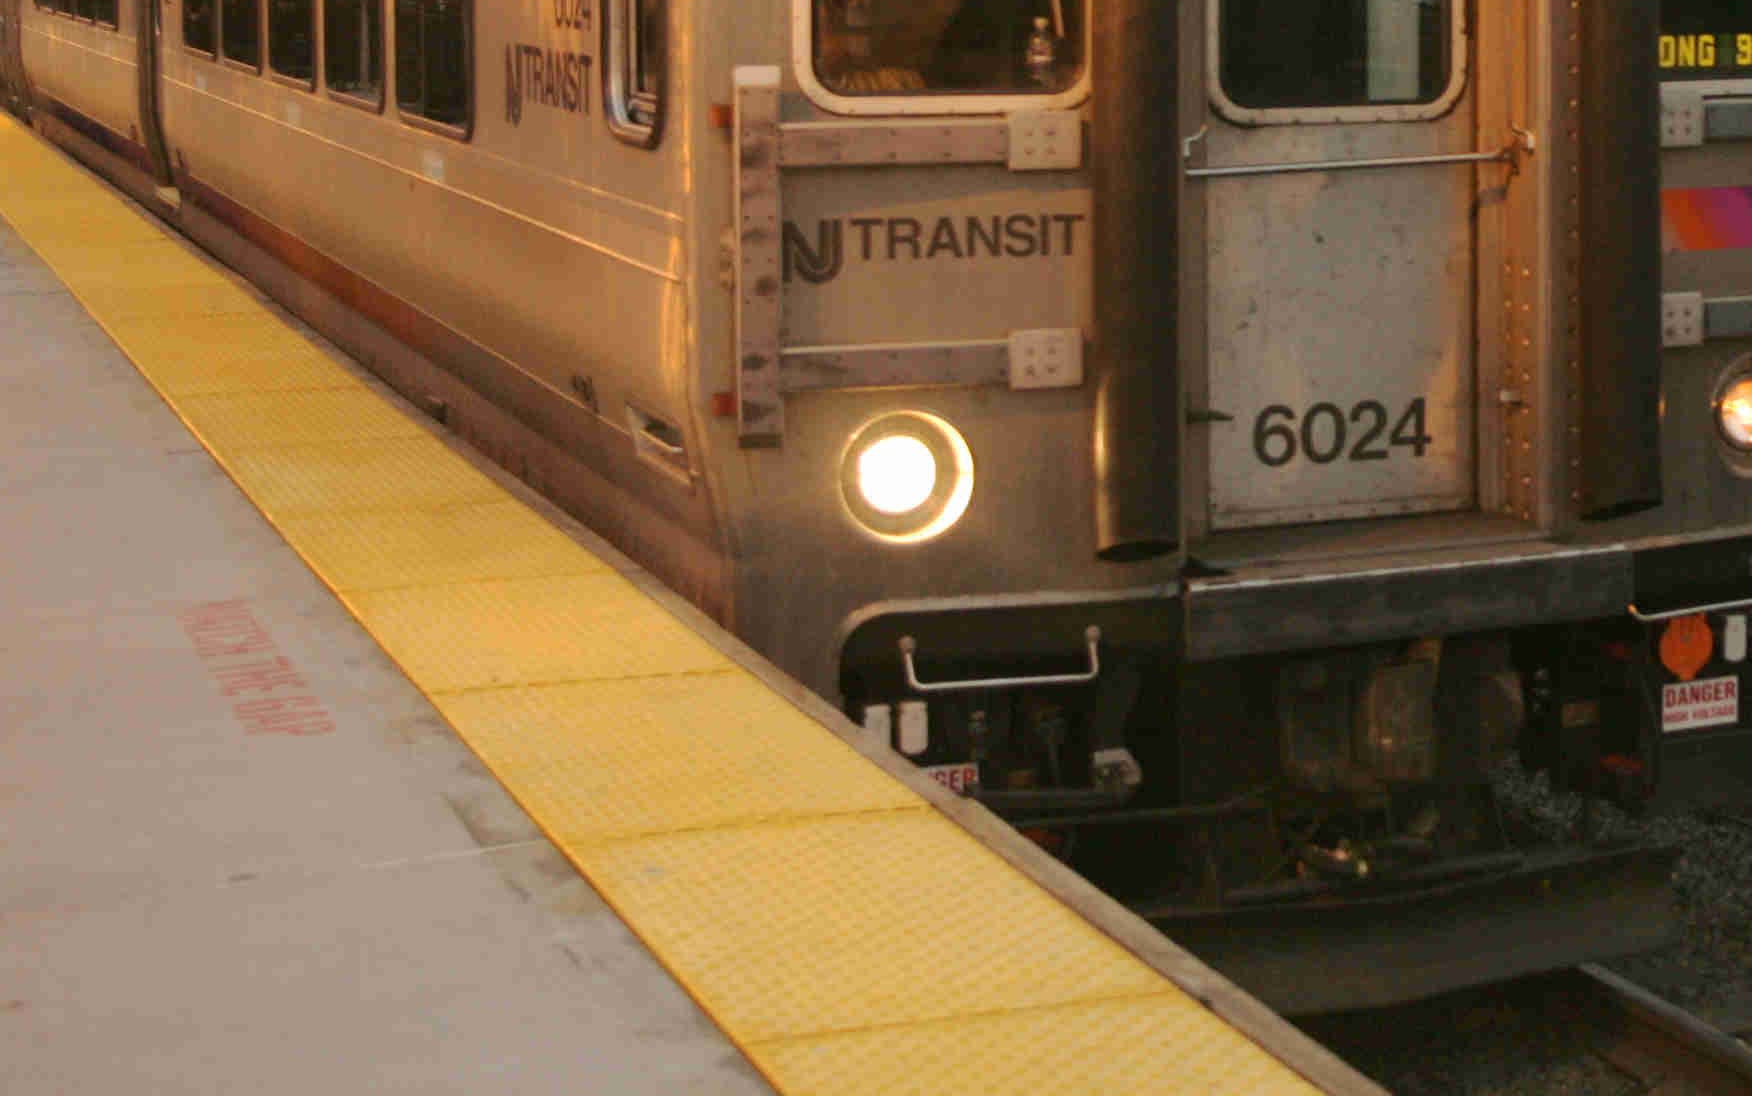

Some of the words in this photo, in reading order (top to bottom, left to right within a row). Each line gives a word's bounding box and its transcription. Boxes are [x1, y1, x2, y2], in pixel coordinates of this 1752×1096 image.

[1658, 34, 1716, 68] ONG
[523, 45, 592, 117] TRANSIT
[850, 213, 1086, 261] TRANSIT
[1253, 395, 1432, 467] 6024
[1664, 679, 1735, 709] DANGER
